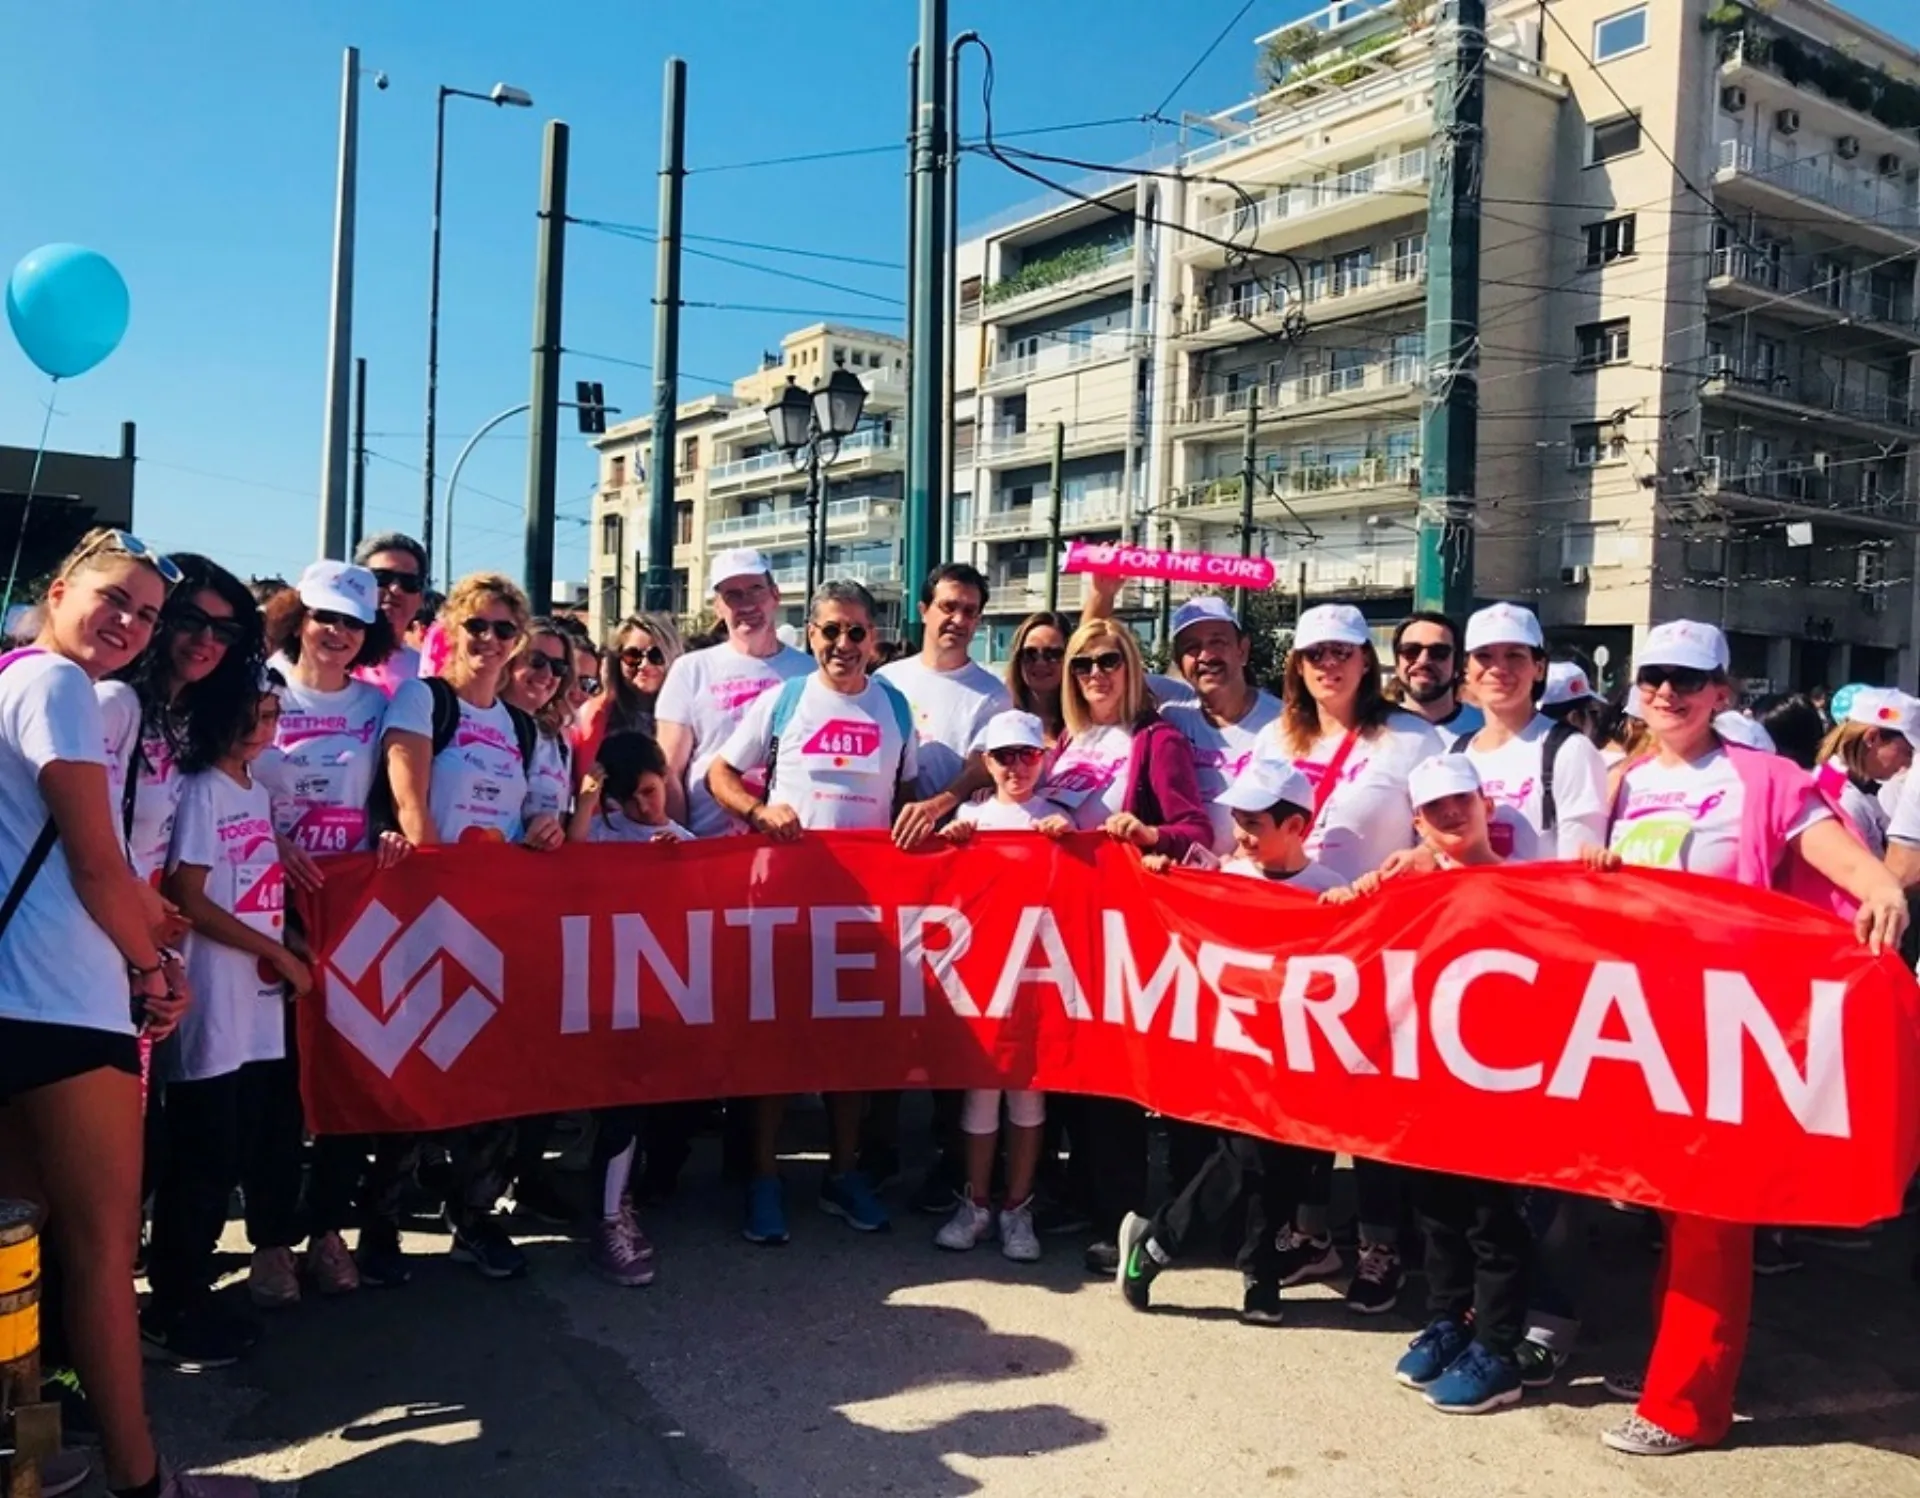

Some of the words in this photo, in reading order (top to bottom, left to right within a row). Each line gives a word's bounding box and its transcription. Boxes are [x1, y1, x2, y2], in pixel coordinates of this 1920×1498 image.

[1119, 551, 1160, 569] FOR
[1166, 554, 1202, 573] THE
[1206, 557, 1266, 580] CURE
[818, 732, 863, 754] 4681
[295, 826, 347, 851] 4748
[559, 904, 1851, 1139] INTERAMERICAN
